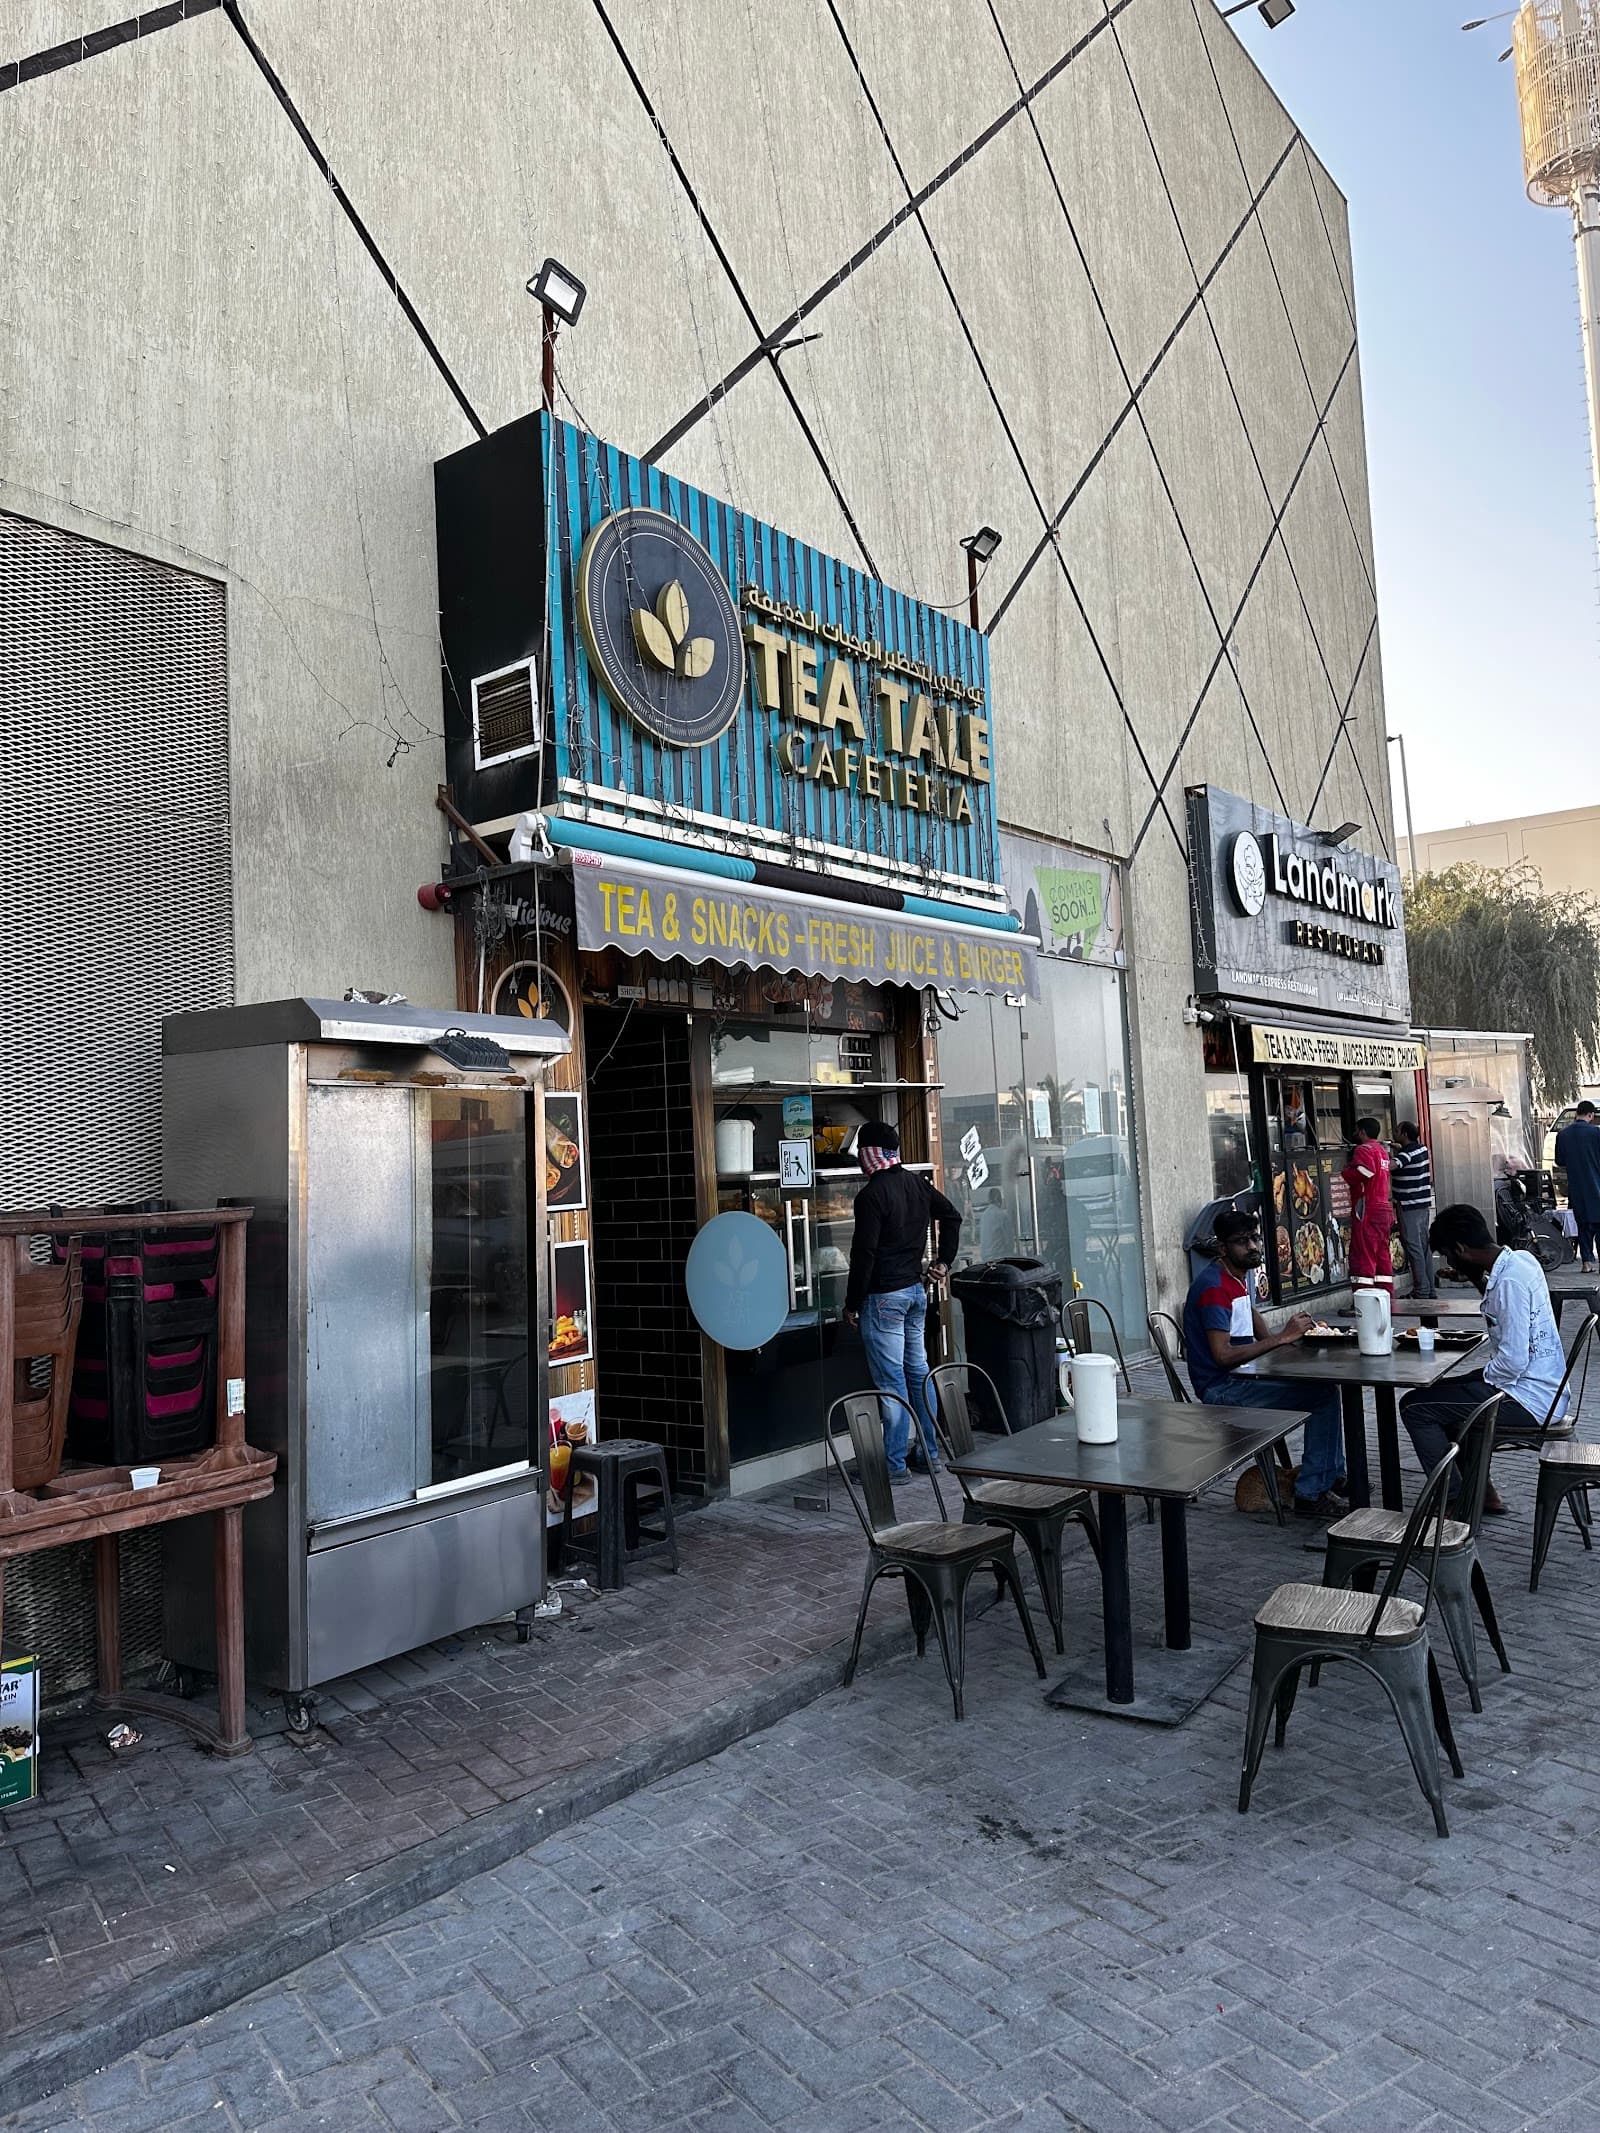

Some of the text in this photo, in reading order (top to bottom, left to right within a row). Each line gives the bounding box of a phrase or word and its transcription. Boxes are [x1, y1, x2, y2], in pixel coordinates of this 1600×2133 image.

[747, 582, 819, 634] الخفيفة
[821, 622, 882, 662] الوجبات
[746, 624, 990, 783] TEA TALE
[779, 730, 973, 824] CAFETERIA
[1049, 879, 1094, 904] COMING
[1266, 832, 1398, 929] Landmark
[598, 882, 655, 938] TEA
[661, 892, 681, 943] &
[884, 931, 938, 976] JUICE
[942, 940, 955, 977] &
[958, 942, 1026, 986] BURGER
[1292, 920, 1385, 965] RESTAURANT
[1264, 976, 1287, 991] EXPRESS
[1287, 980, 1319, 998] RESTAURANT
[1264, 1033, 1284, 1059] TEA
[1282, 1035, 1291, 1060] &
[1342, 1042, 1363, 1066] JUICES
[1363, 1043, 1369, 1066] &
[1368, 1044, 1396, 1068] BROSTED
